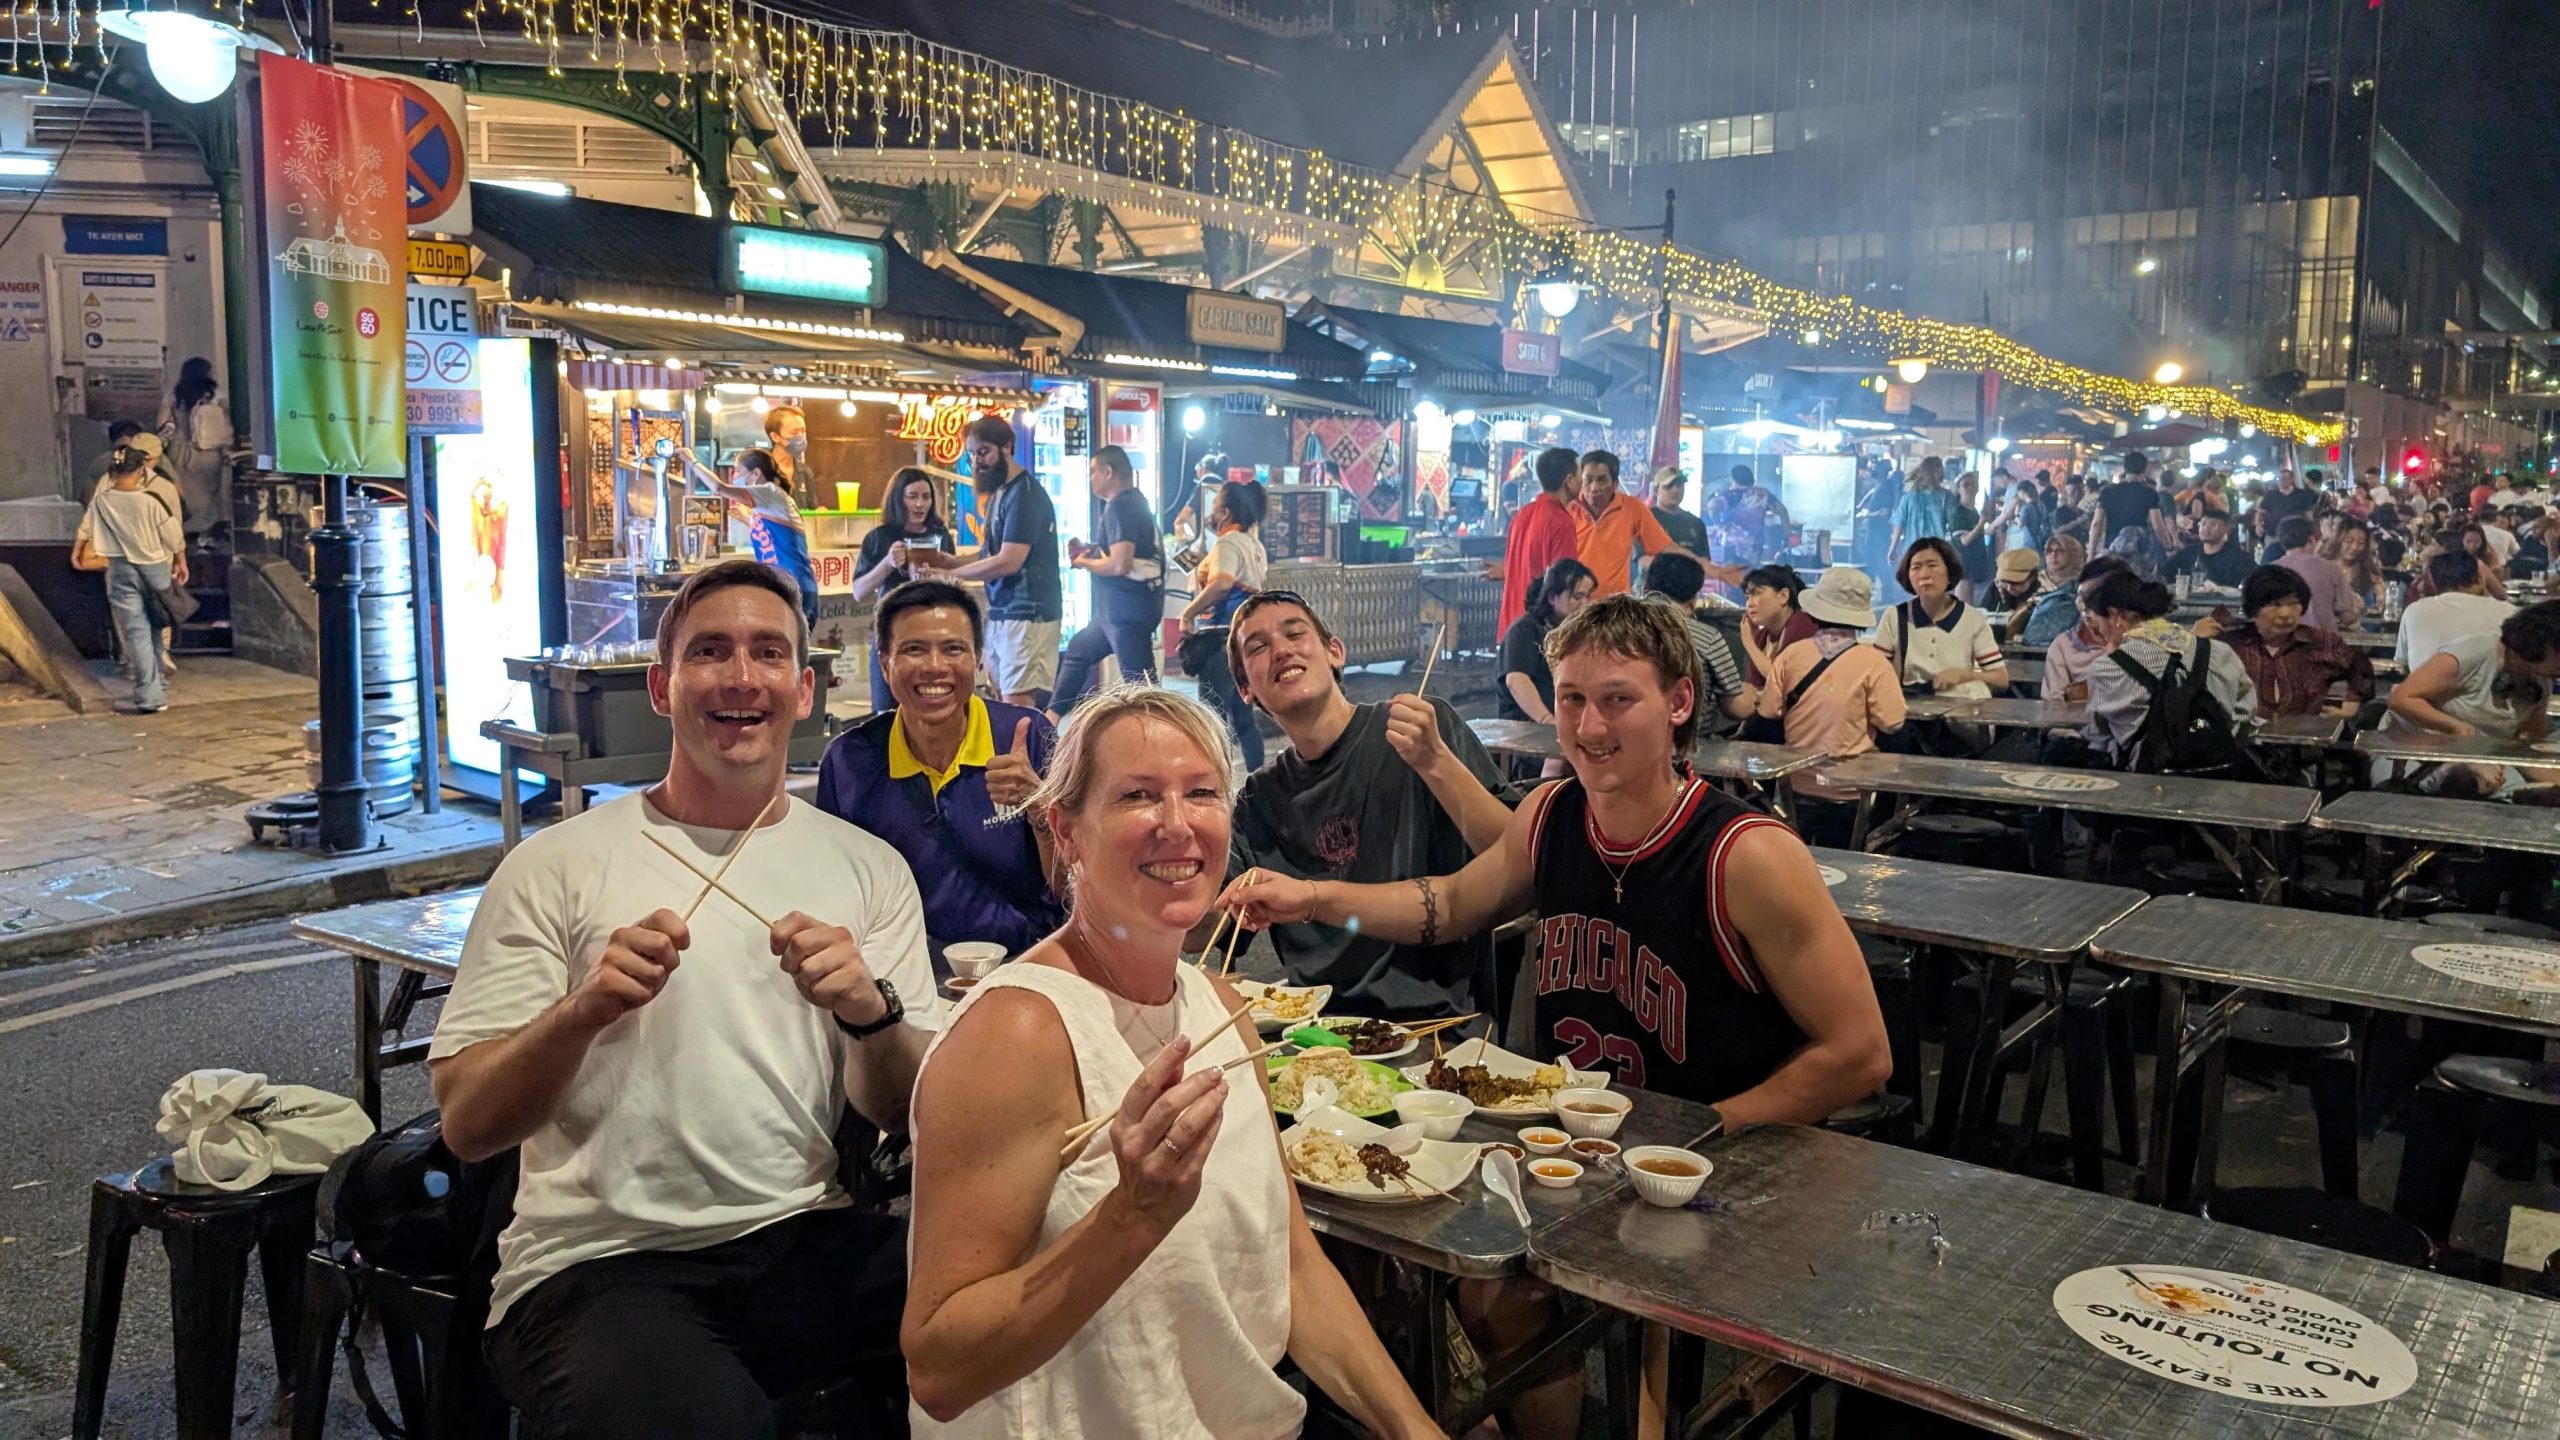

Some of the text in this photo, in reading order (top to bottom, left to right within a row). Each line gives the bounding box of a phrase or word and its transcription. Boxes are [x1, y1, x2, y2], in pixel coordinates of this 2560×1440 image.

[416, 247, 465, 275] 7.00pm
[361, 312, 375, 324] SG
[361, 323, 375, 335] 60
[2201, 1287, 2252, 1304] fine
[2203, 1307, 2354, 1349] Clear your
[2250, 1308, 2359, 1340] table to
[2282, 1305, 2363, 1329] avoid
[2086, 1304, 2380, 1389] NO TOUTING
[2100, 1330, 2328, 1399] FREE SEATING
